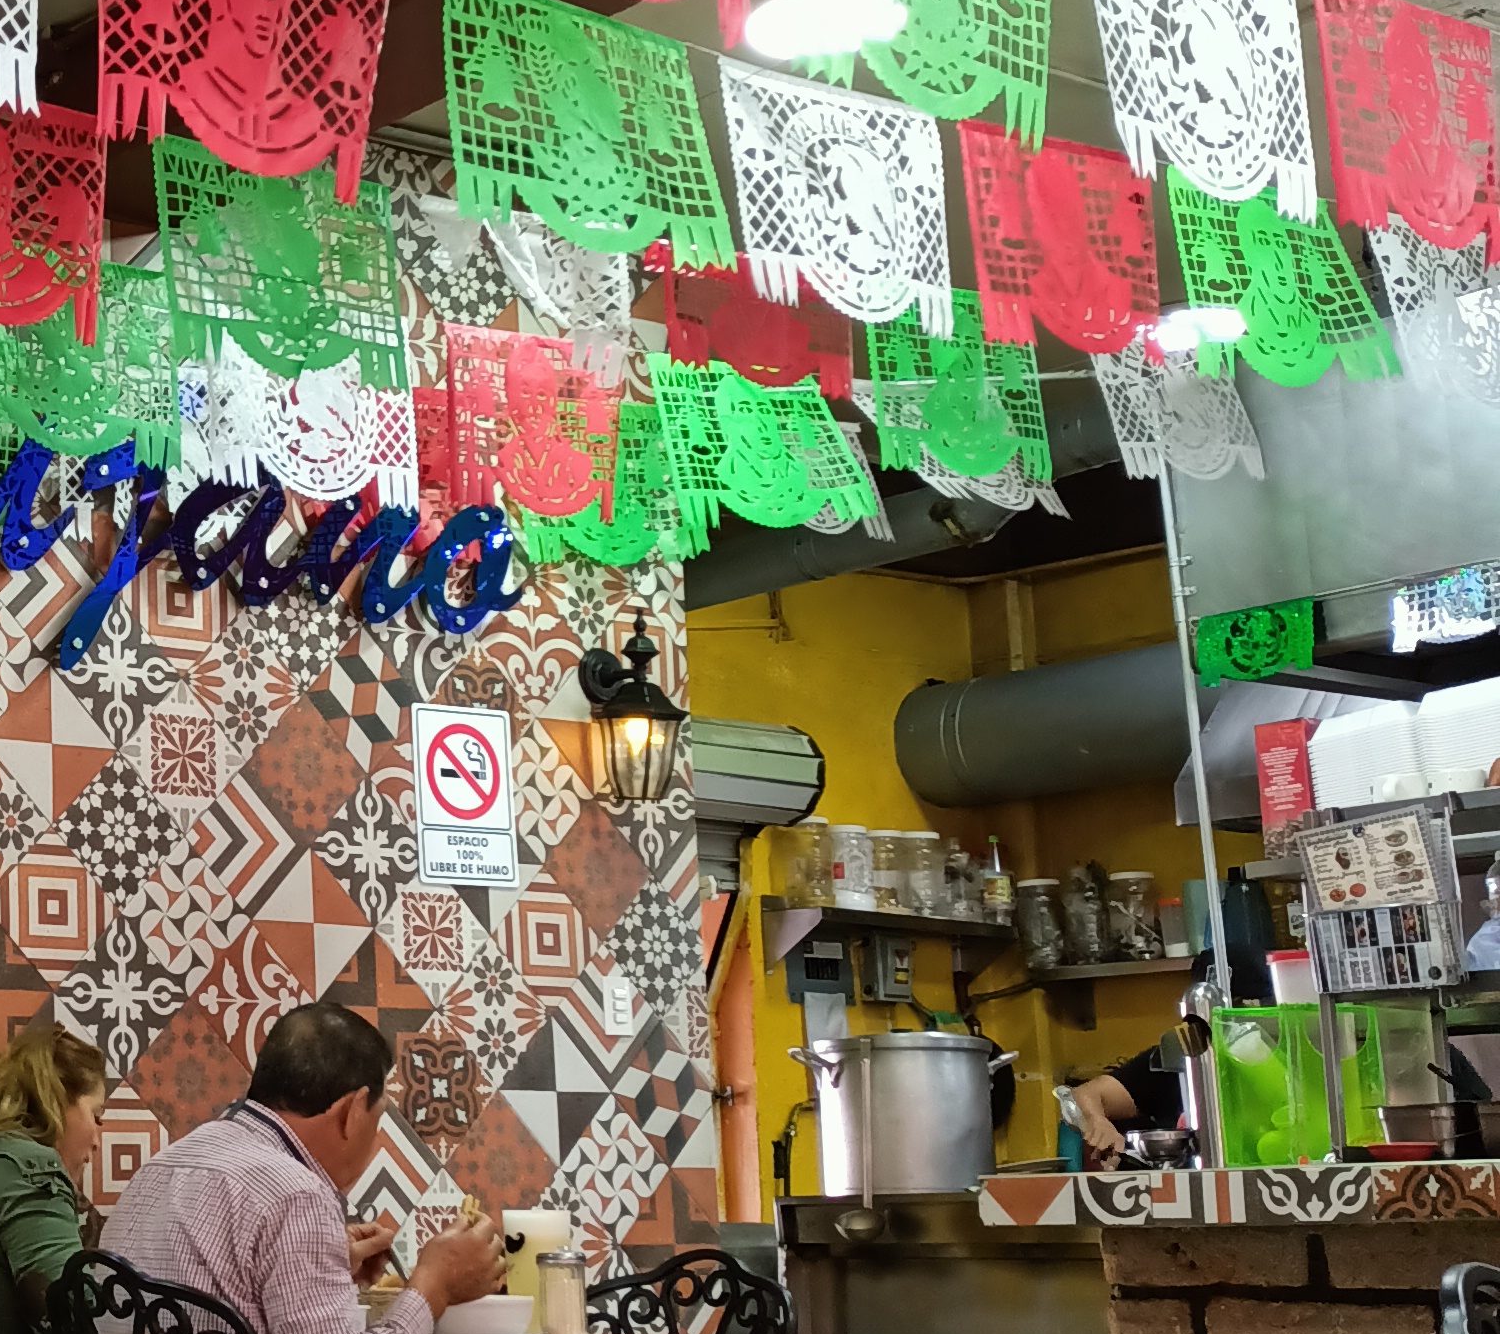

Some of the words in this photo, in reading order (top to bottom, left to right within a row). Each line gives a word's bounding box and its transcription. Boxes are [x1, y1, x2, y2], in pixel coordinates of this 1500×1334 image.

[162, 151, 225, 186] VIVA
[1174, 186, 1220, 211] VIVA
[446, 835, 489, 848] ESPACIO
[456, 849, 483, 862] 100%
[430, 861, 458, 873] LIBRE
[460, 863, 474, 874] DE
[476, 863, 510, 876] HUMO
